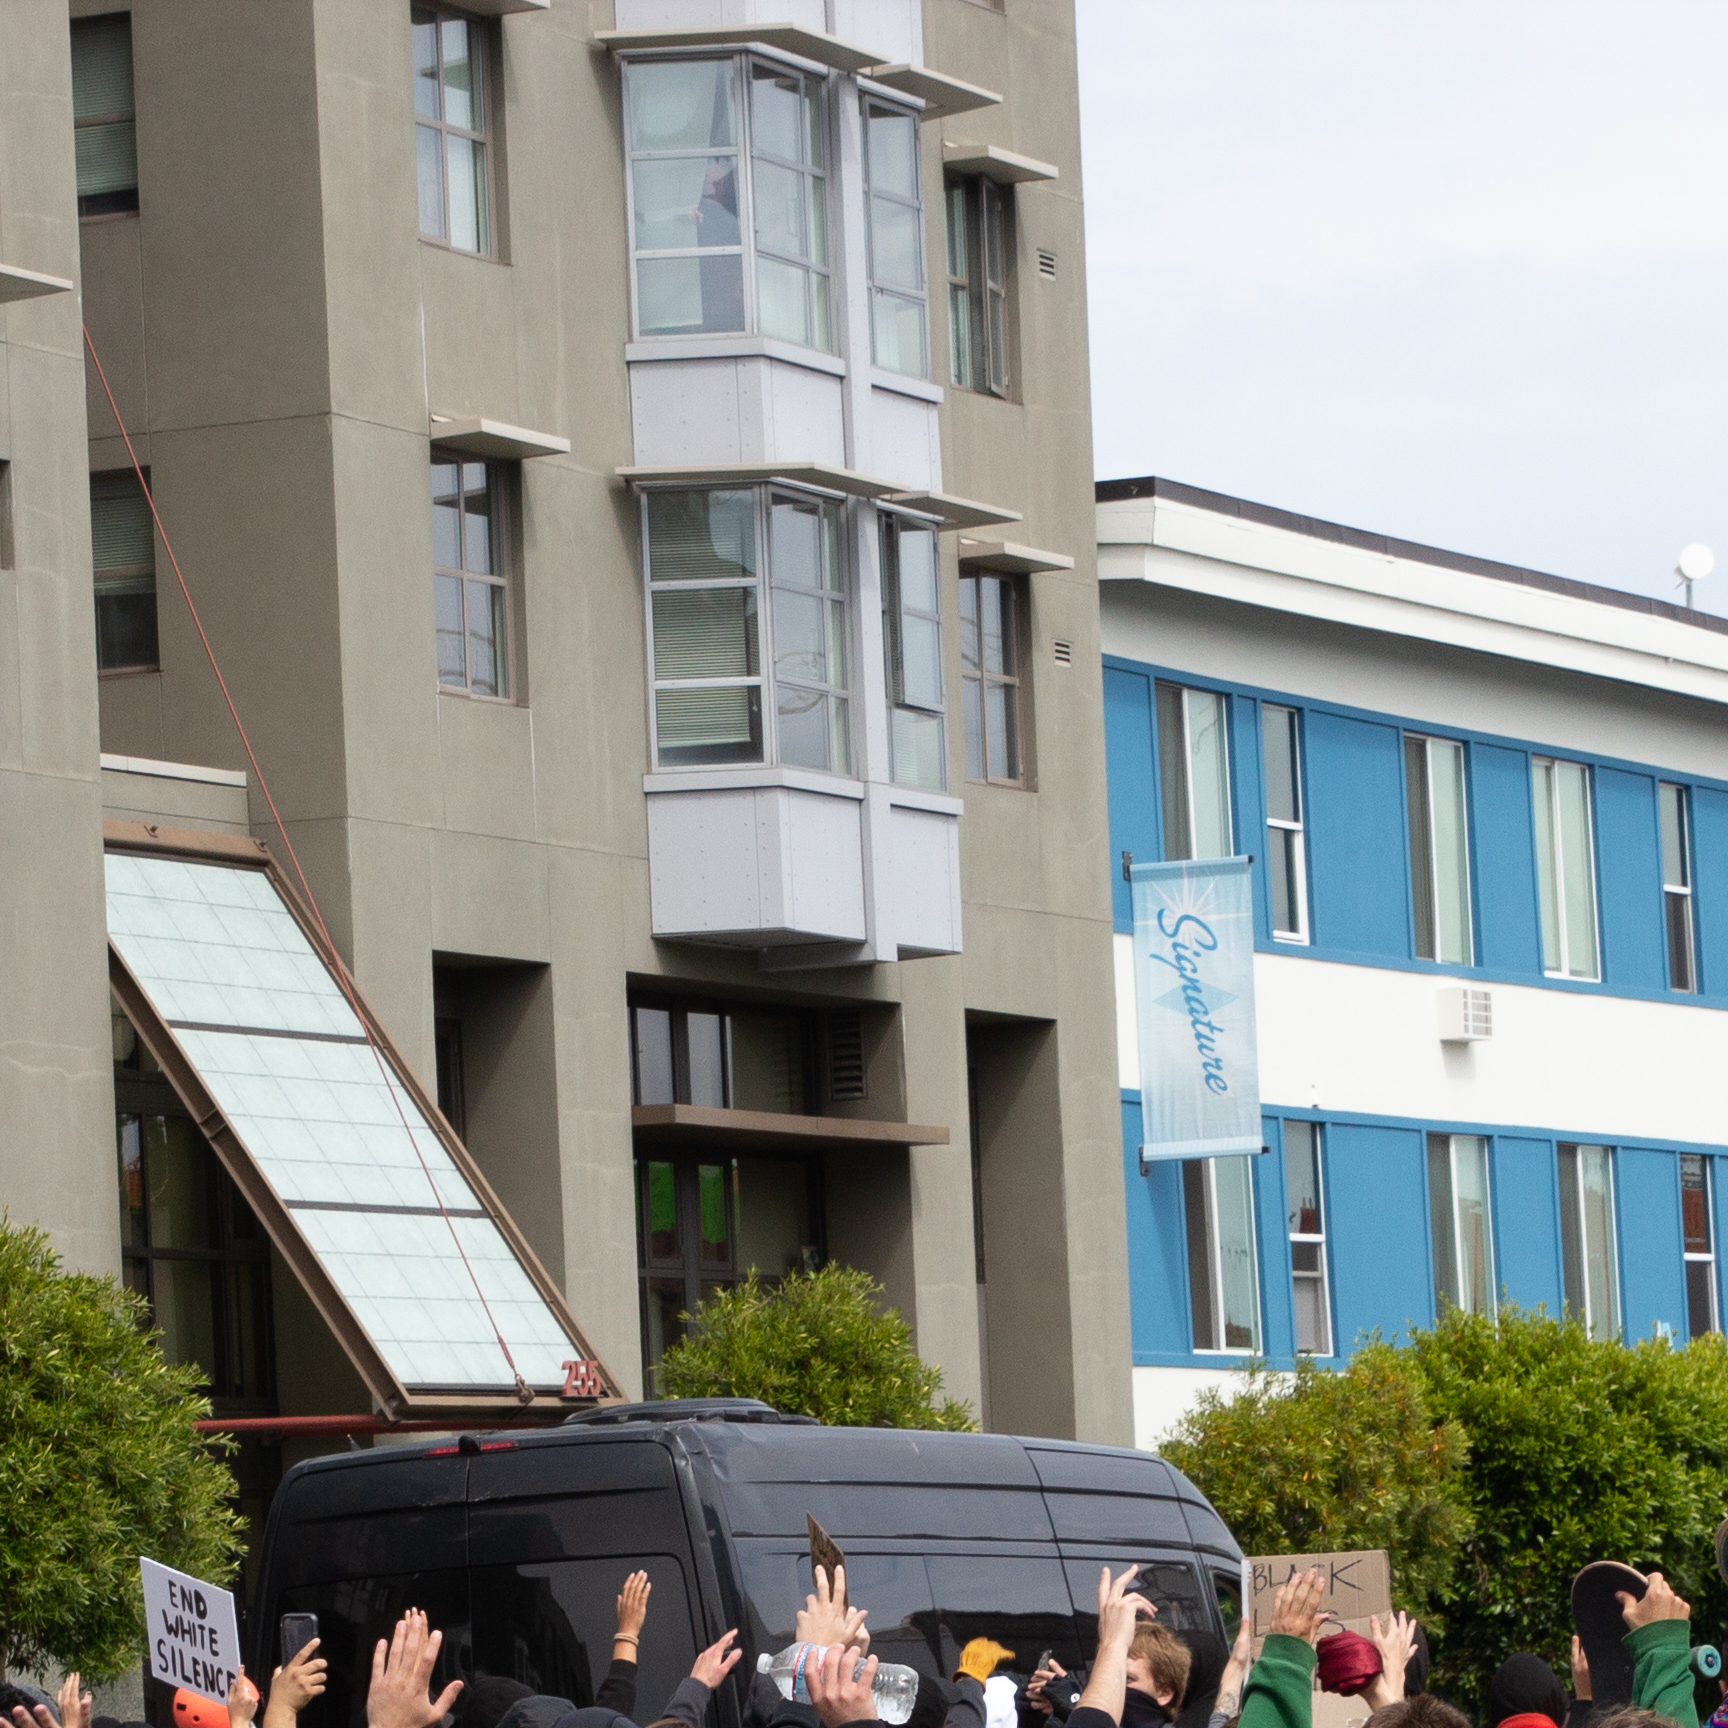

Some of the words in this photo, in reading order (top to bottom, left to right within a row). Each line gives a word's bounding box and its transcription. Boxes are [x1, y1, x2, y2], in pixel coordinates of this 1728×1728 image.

[1149, 907, 1229, 1096] Signature
[561, 1359, 602, 1398] 255
[168, 1579, 208, 1620] END
[162, 1609, 220, 1654] WHITE
